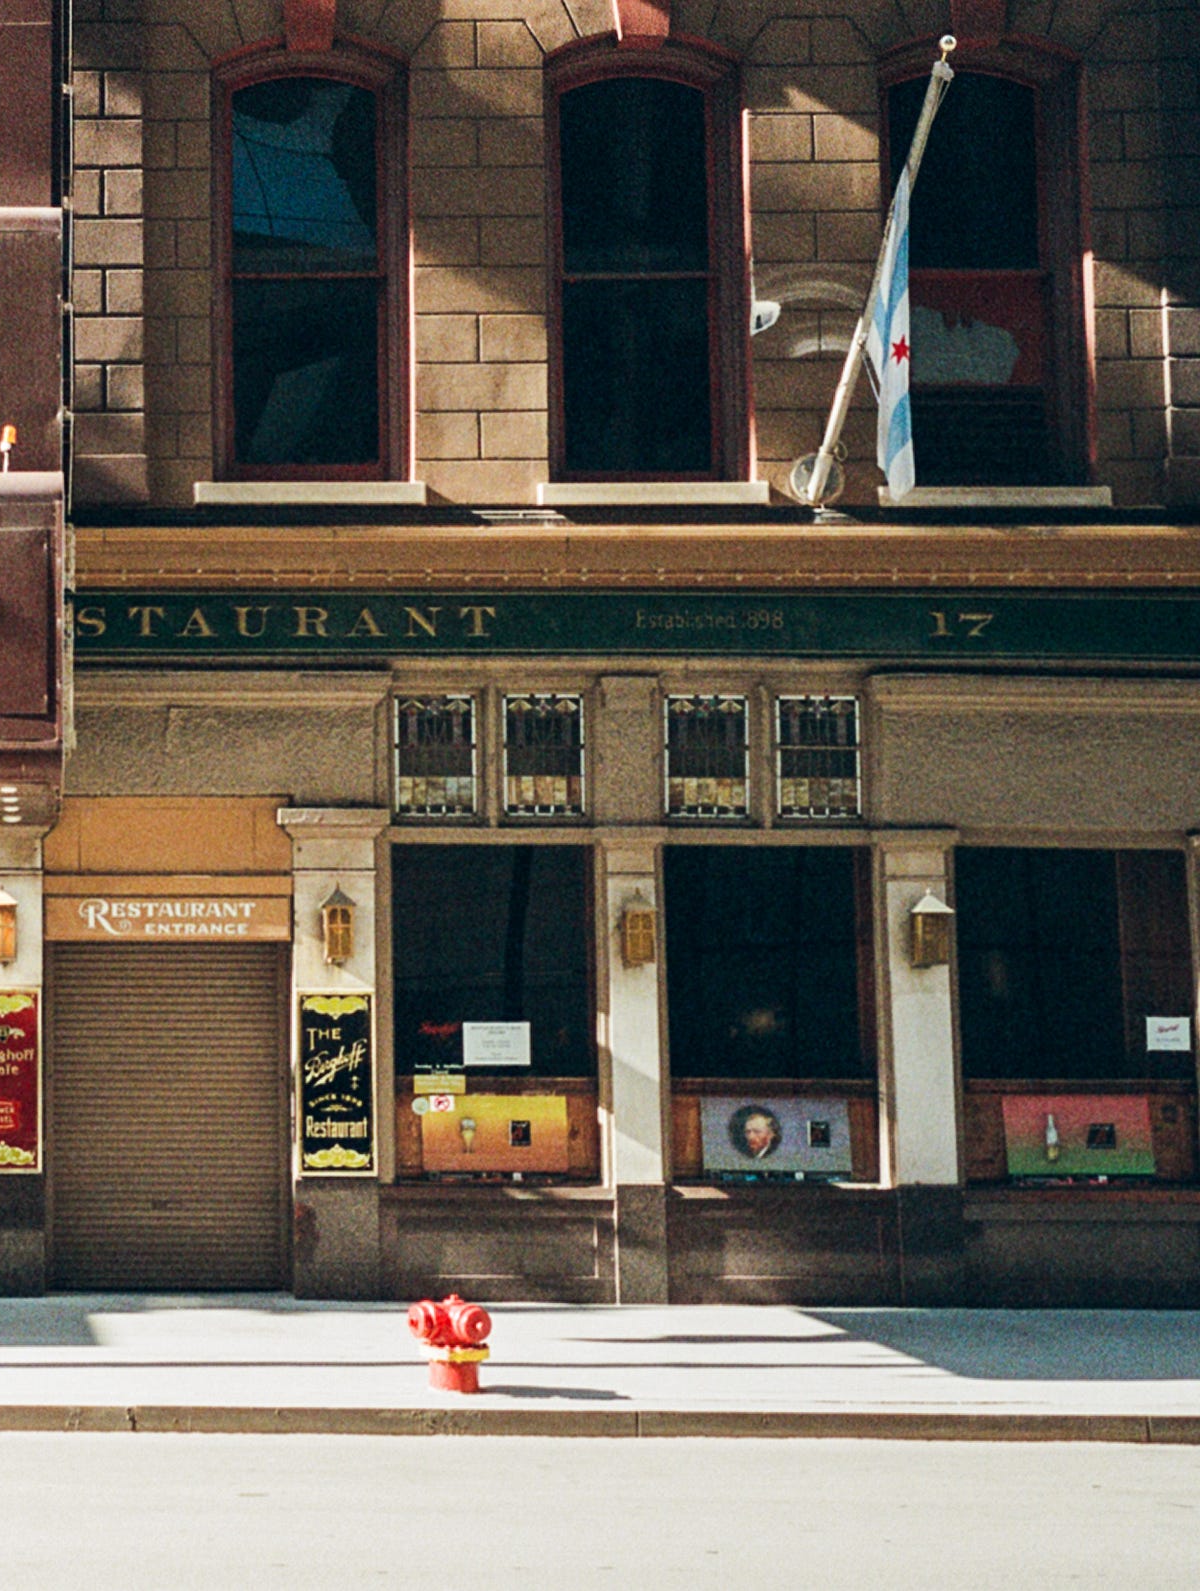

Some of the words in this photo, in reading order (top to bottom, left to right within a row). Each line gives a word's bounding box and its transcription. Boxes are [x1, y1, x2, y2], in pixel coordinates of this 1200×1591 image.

[76, 605, 498, 638] STAURANT
[928, 610, 995, 637] 17
[78, 898, 256, 935] RESTAURANT
[144, 922, 249, 935] ENTRANCE
[306, 1027, 342, 1050] THE
[304, 1038, 368, 1087] Berghoff
[306, 1115, 368, 1138] Restaurant
